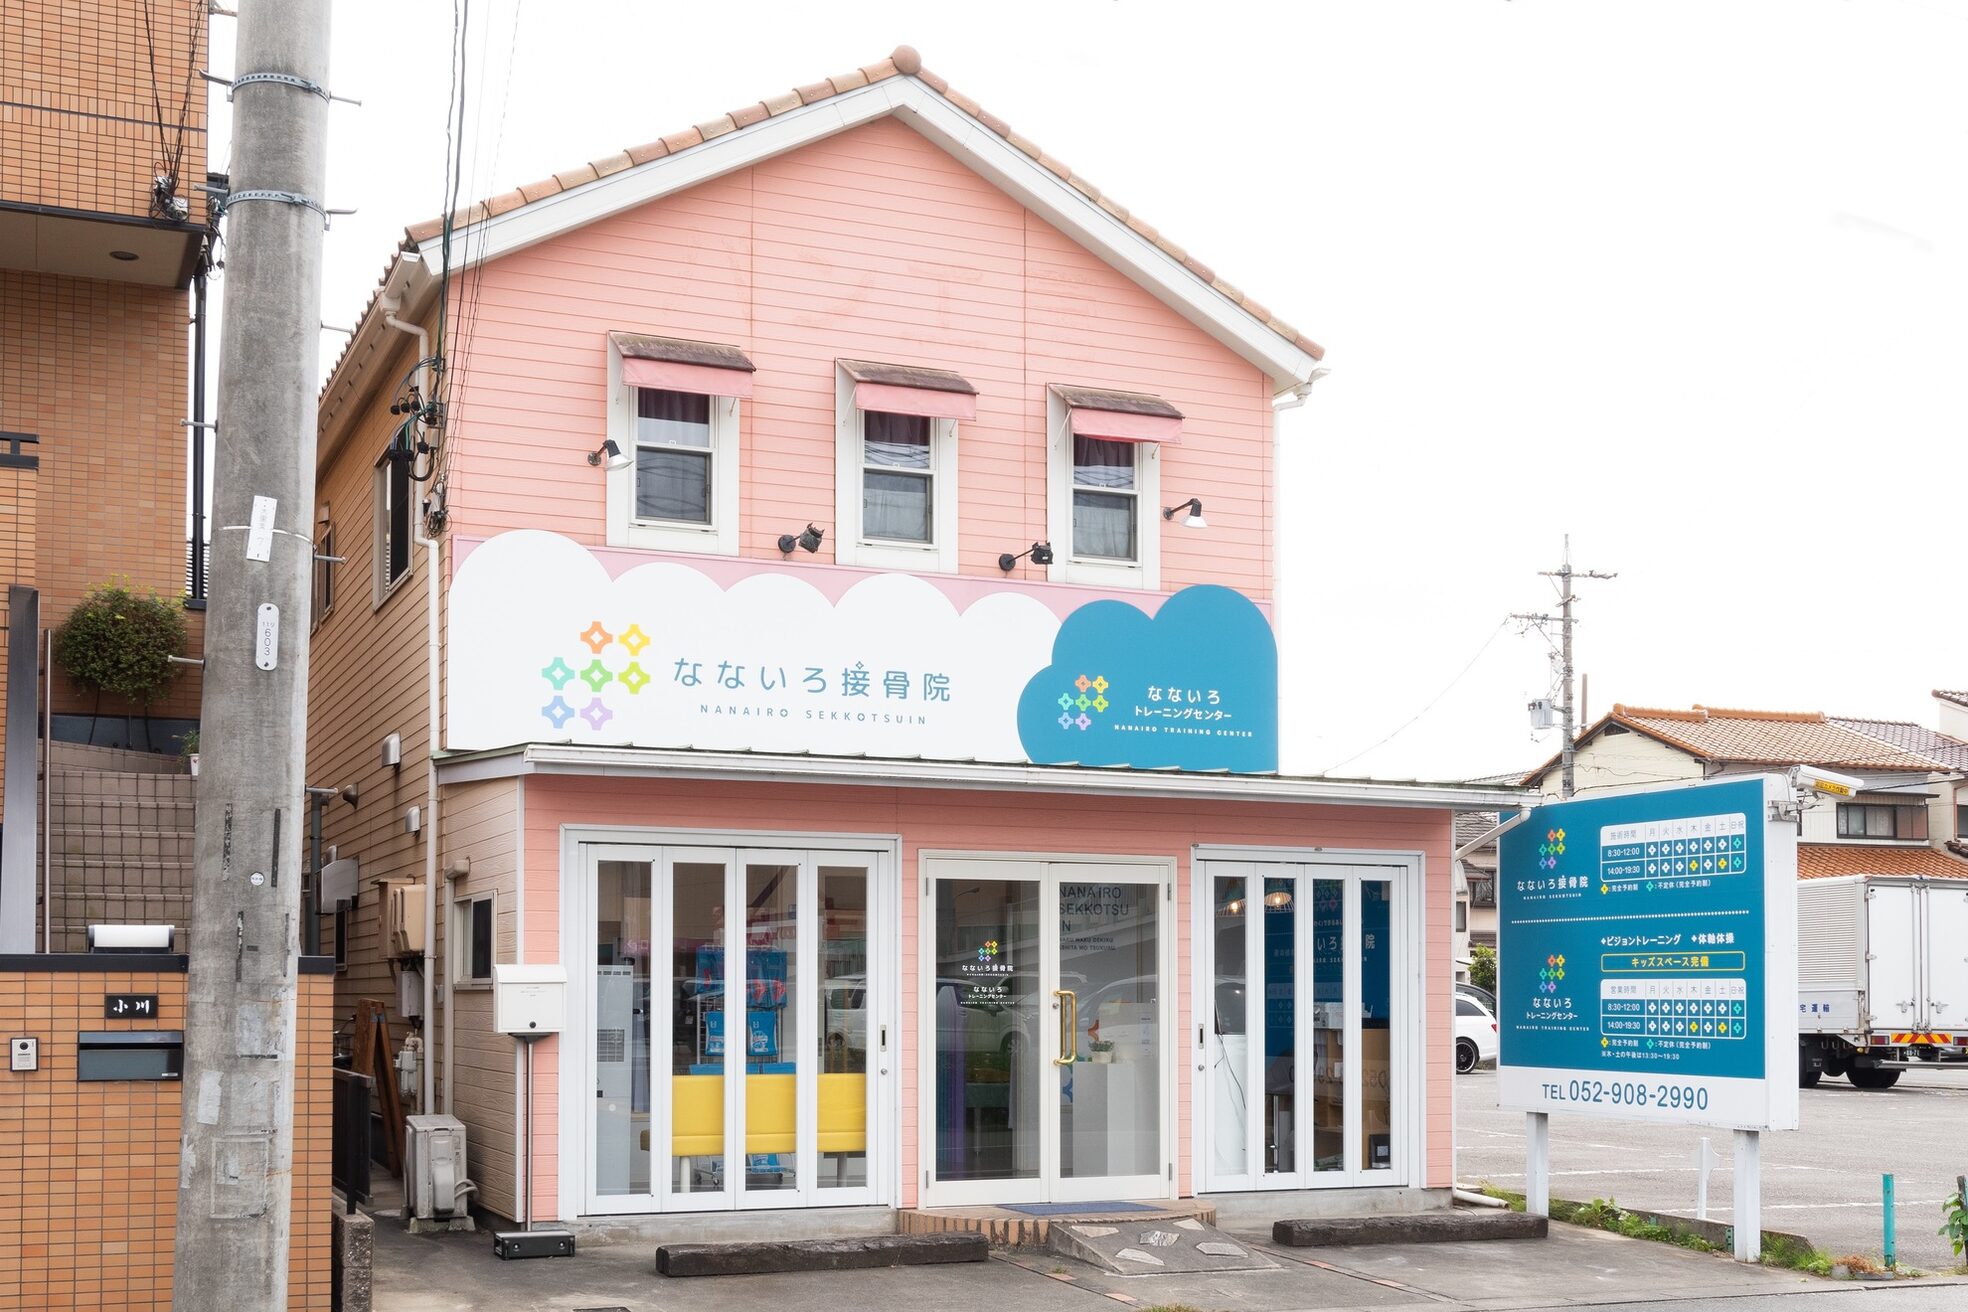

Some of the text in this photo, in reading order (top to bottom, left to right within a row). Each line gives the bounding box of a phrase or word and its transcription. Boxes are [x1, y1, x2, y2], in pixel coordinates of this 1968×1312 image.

[264, 628, 272, 656] 603
[674, 657, 951, 702] なないろ接骨院
[1147, 685, 1221, 705] なないろ
[700, 704, 926, 725] NANAIRO SEKKOTSUIN
[1135, 705, 1232, 721] トレーニングセンター
[1114, 724, 1253, 738] NANAIRO TRAINING CENTER
[1608, 847, 1640, 858] 8:30-12:00
[1608, 865, 1640, 875] 14:00-19:30
[1517, 875, 1589, 892] なないろ接骨院
[1606, 934, 1682, 946] ビジョントレーニング
[1631, 955, 1709, 968] キッズスペース完備
[113, 999, 150, 1014] 小川
[1533, 997, 1572, 1008] なないろ
[1608, 1003, 1640, 1012] 8:30-12:00
[1526, 1011, 1578, 1020] トレーニングセンター
[1608, 1021, 1641, 1030] 14:00-19:30
[1542, 1079, 1708, 1110] TEL 052-908-2990
